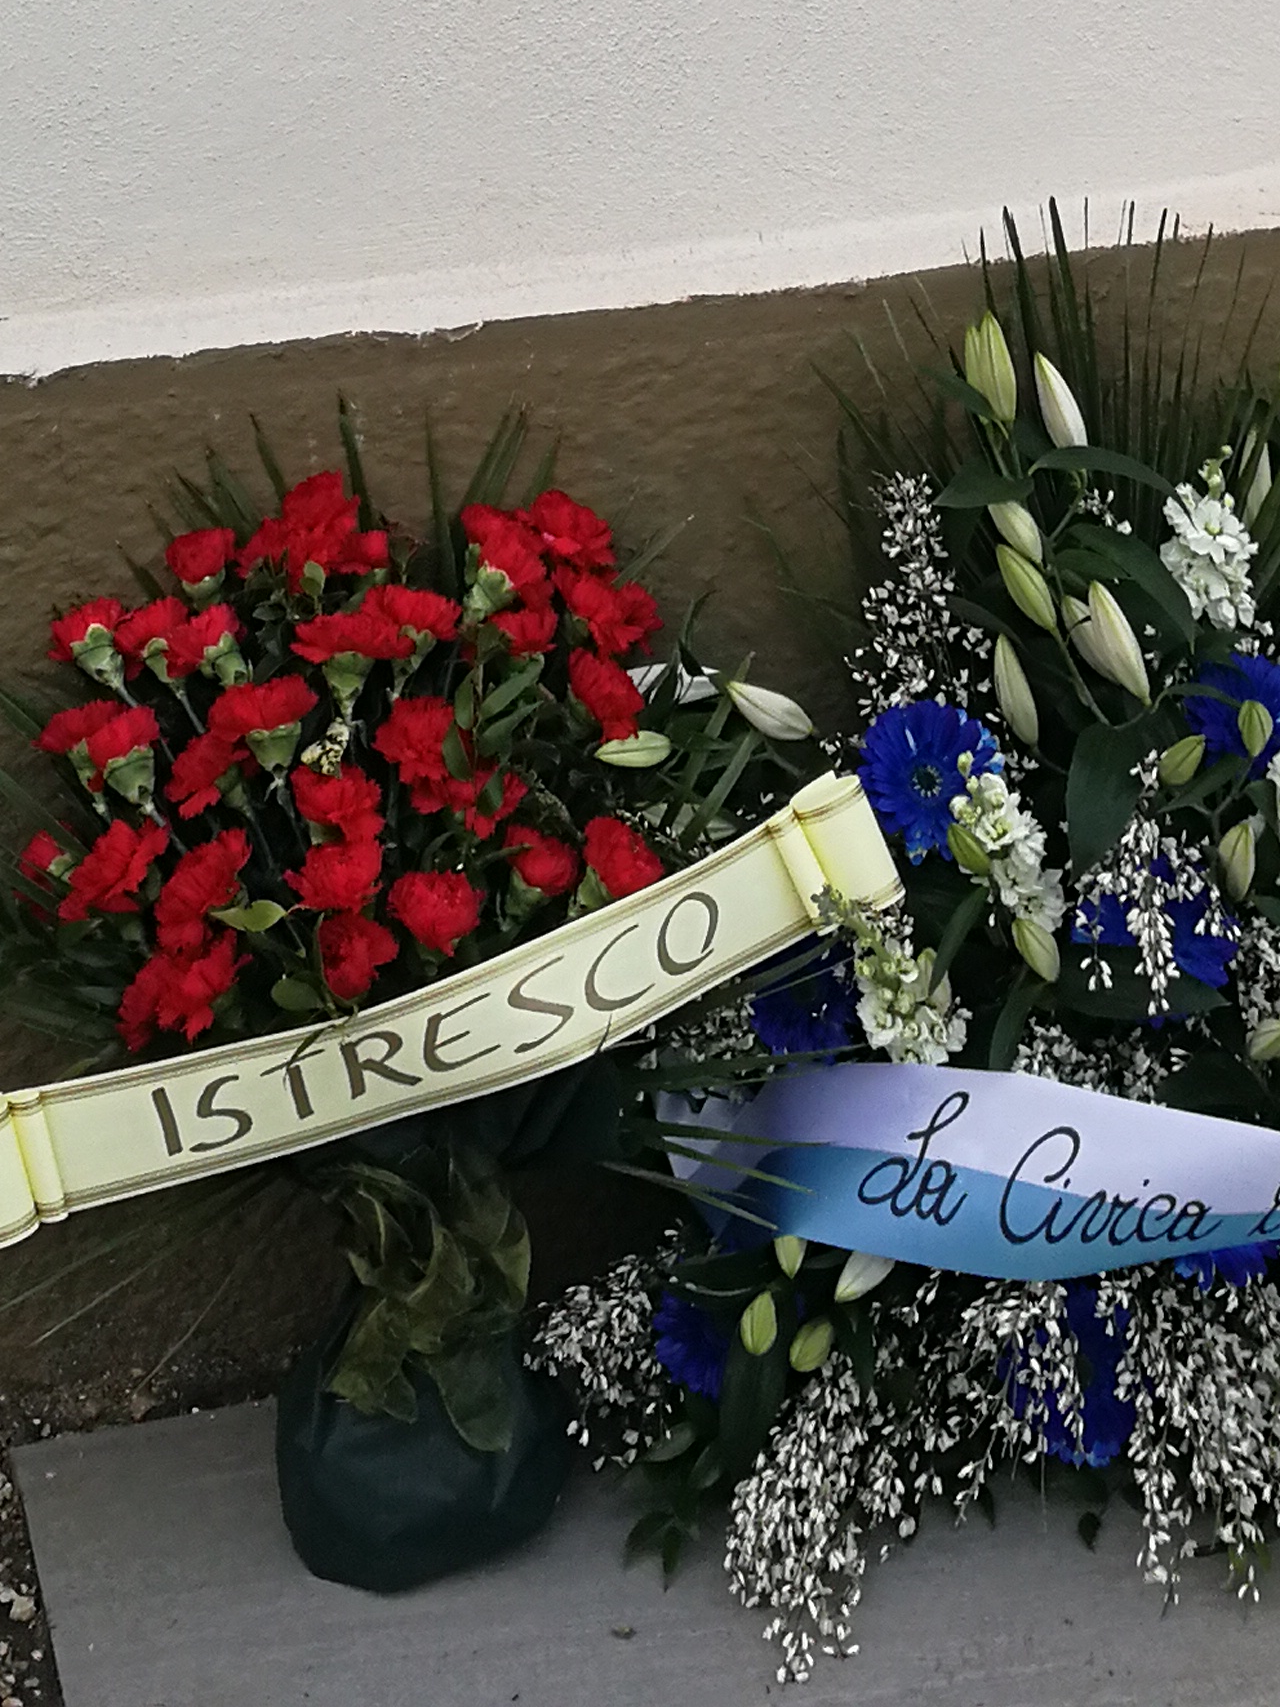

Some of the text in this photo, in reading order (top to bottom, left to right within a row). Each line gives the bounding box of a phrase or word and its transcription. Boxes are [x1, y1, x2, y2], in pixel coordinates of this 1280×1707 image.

[151, 890, 720, 1157] ISTRESCO
[857, 1090, 969, 1227] La
[999, 1125, 1222, 1247] Civica
